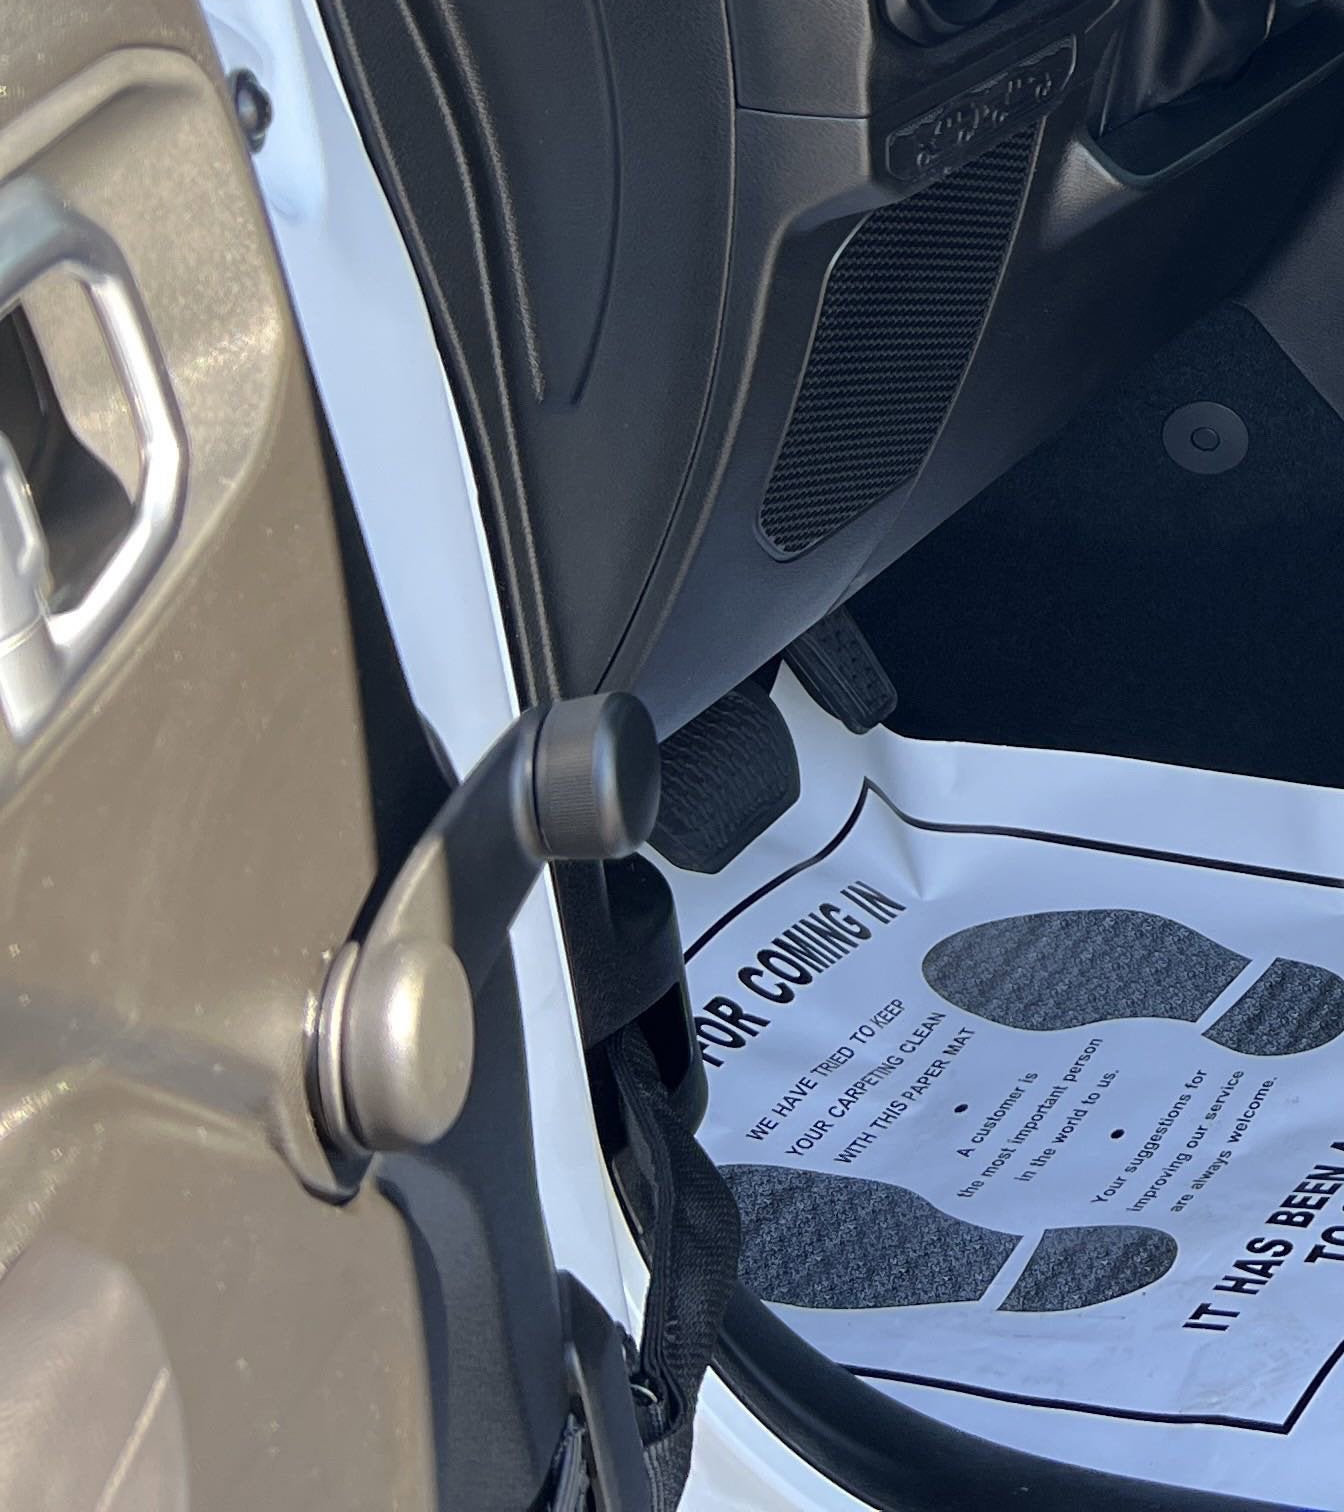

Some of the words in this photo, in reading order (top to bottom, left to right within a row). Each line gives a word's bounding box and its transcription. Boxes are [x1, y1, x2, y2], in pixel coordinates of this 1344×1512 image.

[737, 903, 873, 1005] COMING
[839, 880, 907, 925] IN
[746, 1117, 779, 1141] WE
[771, 1077, 818, 1118] HAVE
[810, 1046, 855, 1077] TRIED
[850, 1024, 876, 1044] TO
[870, 998, 905, 1029] KEEP
[785, 1119, 834, 1157] YOUR
[828, 1055, 904, 1118] CARPETING
[899, 1011, 947, 1054] CLEAN
[833, 1132, 877, 1164] WITH
[869, 1099, 908, 1130] THIS
[901, 1059, 951, 1101] PAPER
[942, 1027, 976, 1056] MAT
[956, 1147, 976, 1158] A
[971, 1085, 1026, 1144] customer
[1018, 1072, 1039, 1084] is
[957, 1180, 985, 1198] the
[981, 1147, 1017, 1178] most
[1007, 1085, 1069, 1145] important
[1062, 1038, 1103, 1083] person
[1029, 1147, 1057, 1168] the
[1051, 1108, 1088, 1144] world
[1081, 1091, 1101, 1105] to
[1096, 1069, 1120, 1088] us.
[1090, 1175, 1127, 1204] Your
[1124, 1093, 1192, 1173] suggestions
[1184, 1069, 1208, 1089] for
[1186, 1125, 1208, 1149] our
[1205, 1070, 1245, 1121] service
[1170, 1193, 1194, 1213] are
[1191, 1149, 1232, 1190] always
[1226, 1077, 1278, 1144] welcome.
[1181, 1302, 1241, 1331] IT
[1212, 1237, 1294, 1295] HAS
